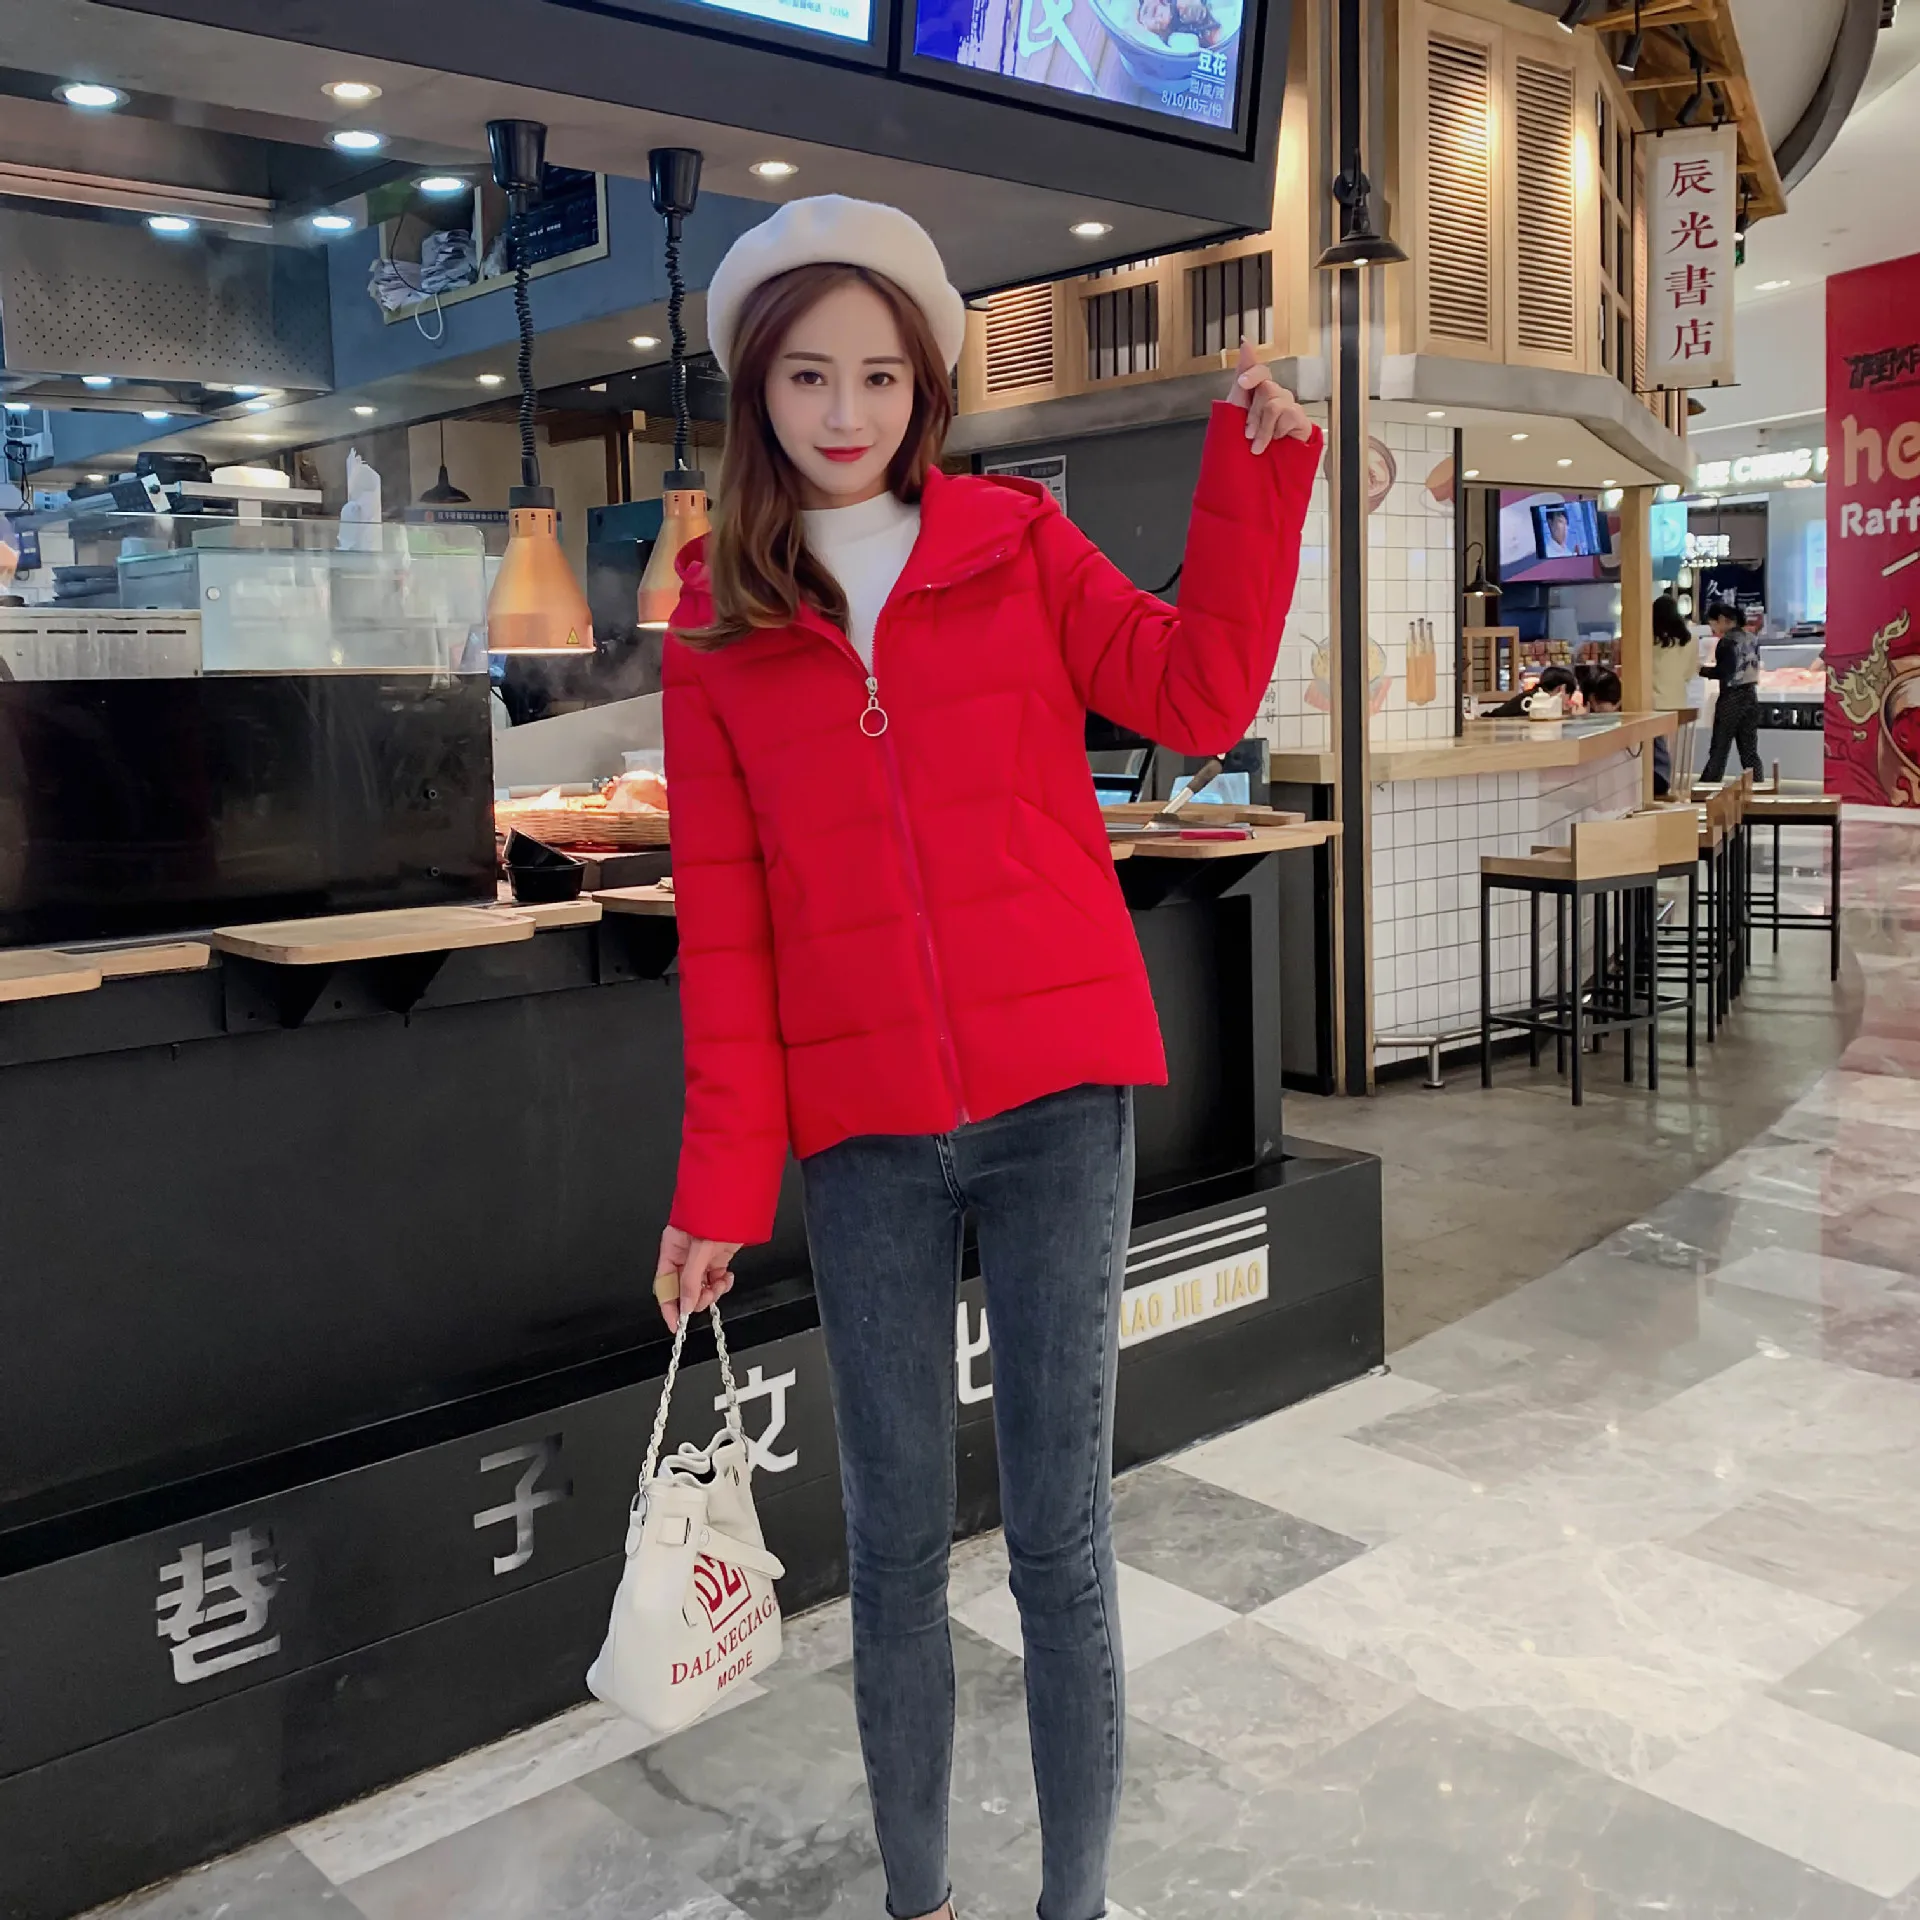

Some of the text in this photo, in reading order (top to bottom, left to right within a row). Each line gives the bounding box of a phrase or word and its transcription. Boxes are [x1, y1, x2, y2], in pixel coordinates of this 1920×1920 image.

[1197, 48, 1228, 76] 豆花
[1161, 90, 1222, 118] 8/10/10元/份
[1664, 159, 1719, 361] 辰光書店
[1840, 496, 1920, 538] Raff
[1171, 1280, 1201, 1322] JIE
[1214, 1262, 1261, 1308] JIAO
[717, 1650, 753, 1691] MODE
